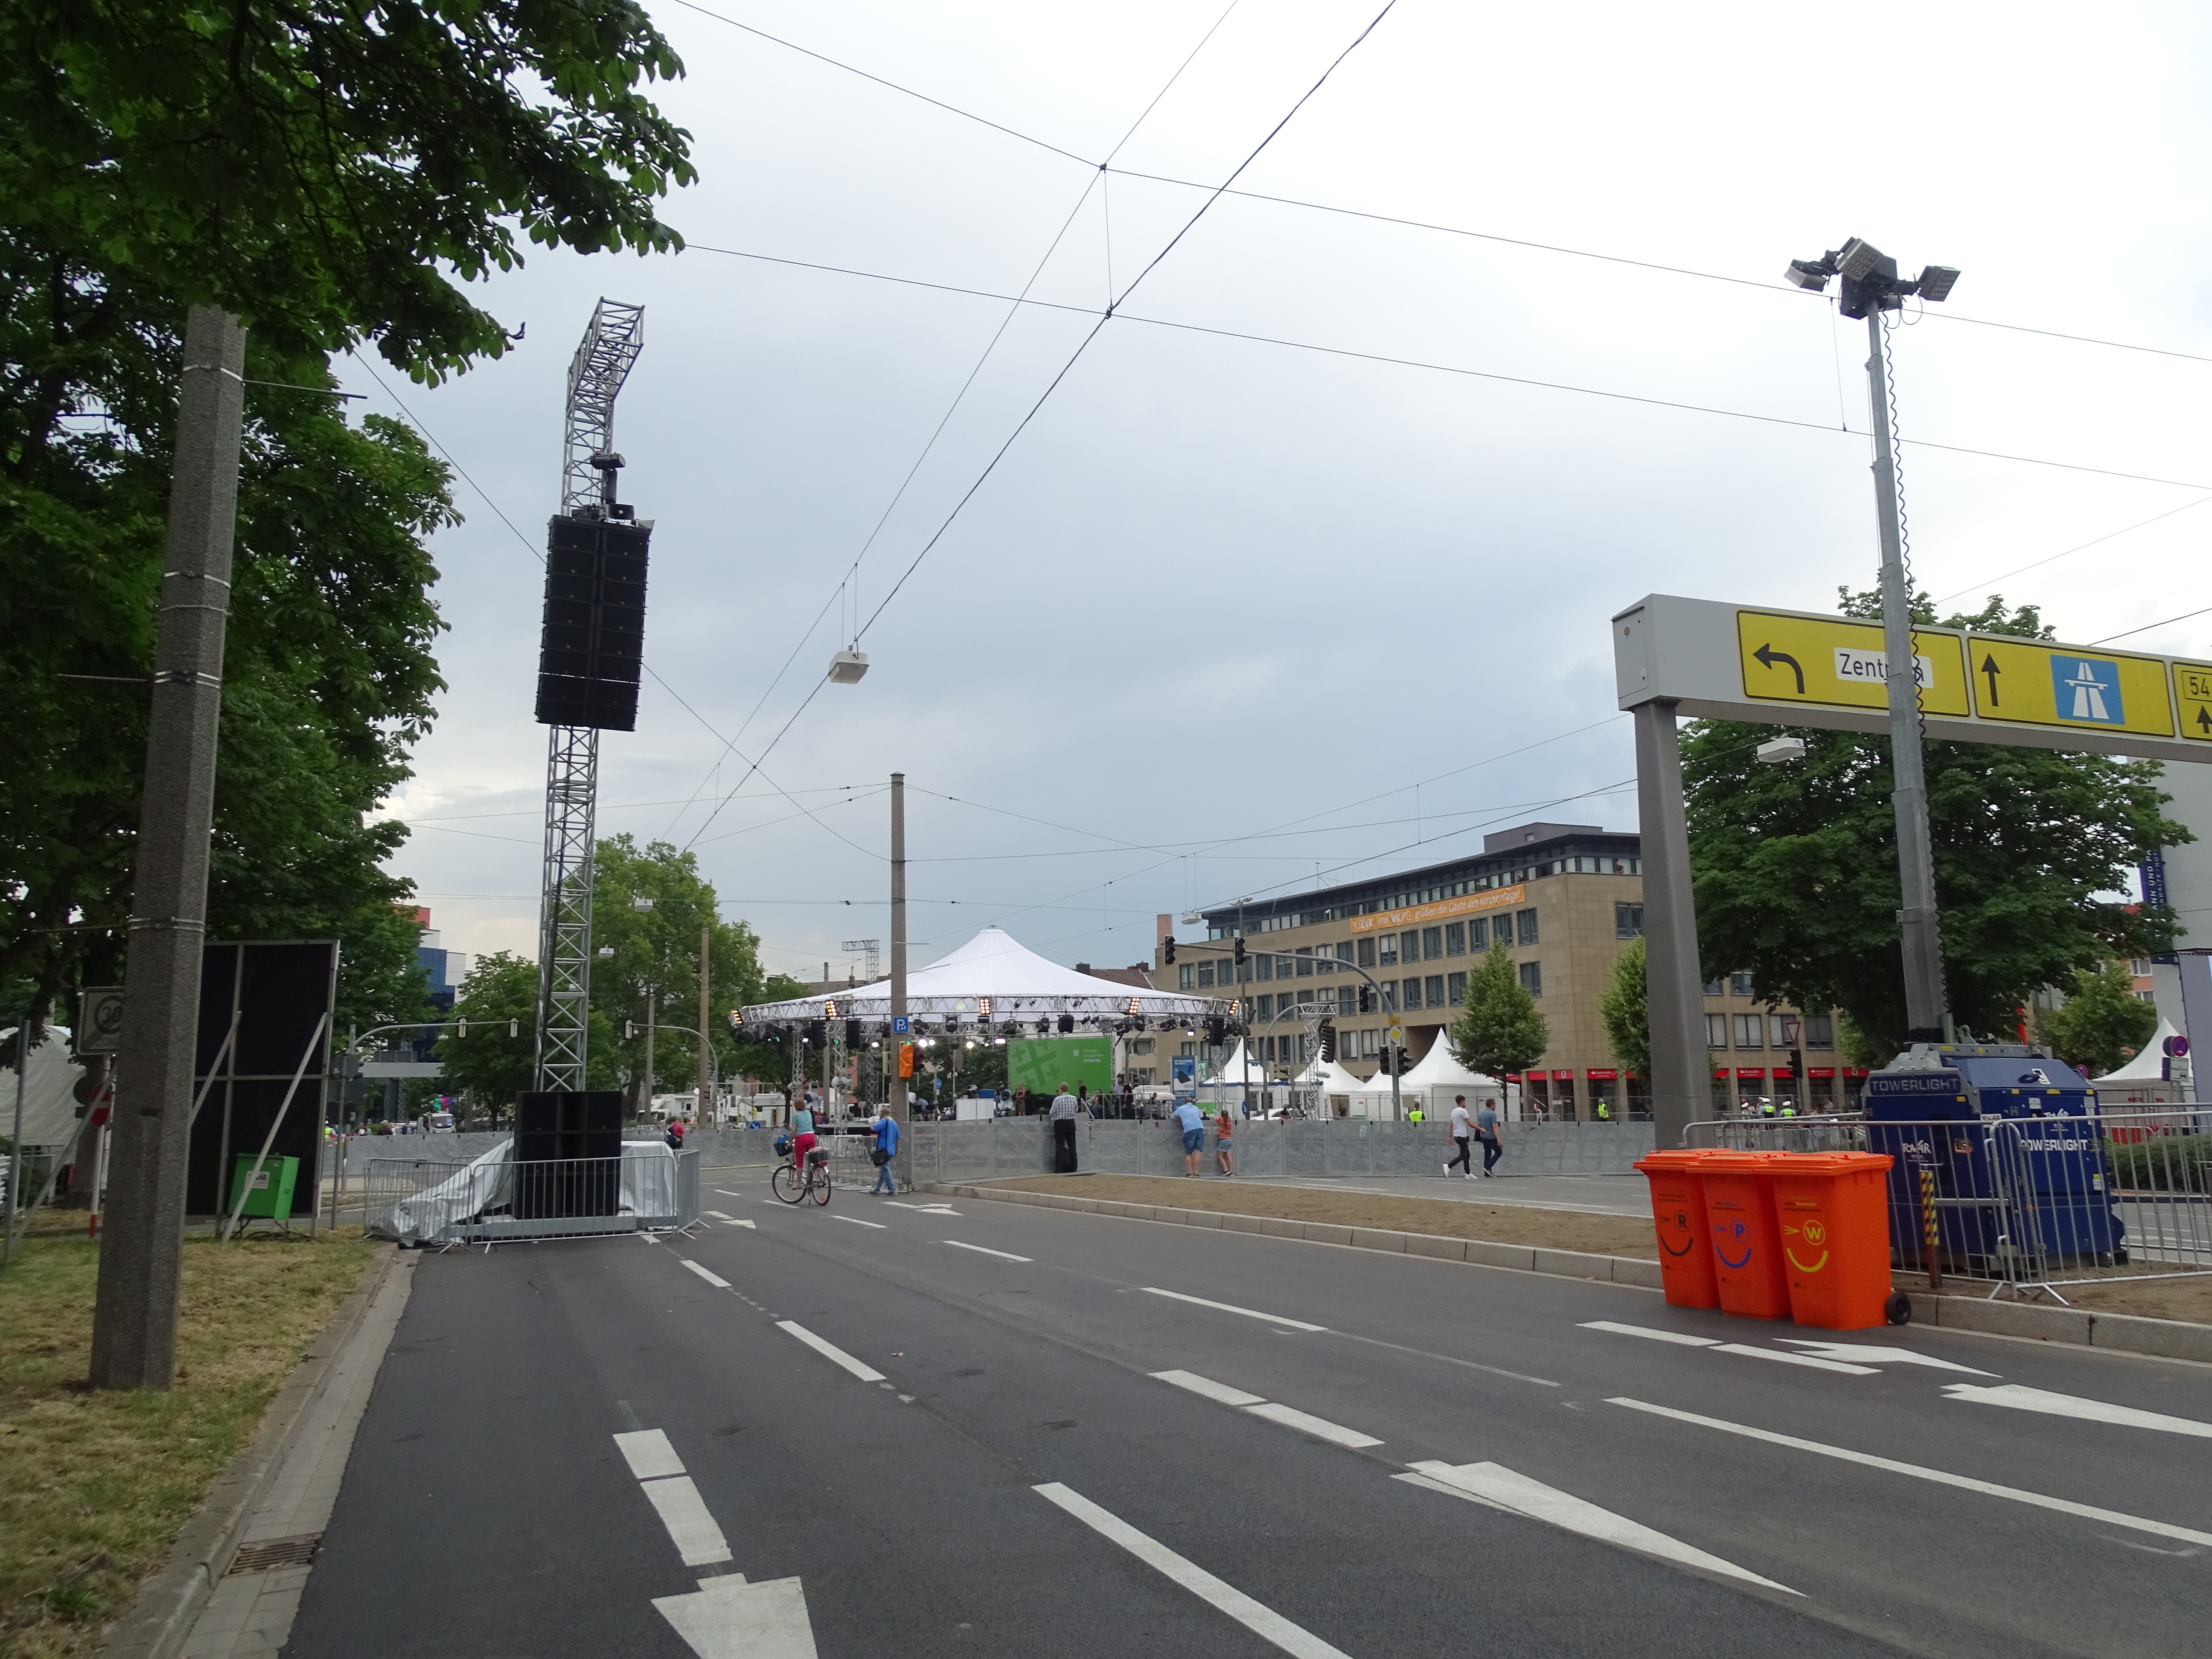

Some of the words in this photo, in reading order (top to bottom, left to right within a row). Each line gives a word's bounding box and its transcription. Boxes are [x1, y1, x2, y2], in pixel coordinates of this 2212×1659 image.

[1839, 653, 1924, 682] Zentrm
[2189, 676, 2209, 697] 54
[1415, 907, 1437, 921] grüßen
[1438, 904, 1447, 914] die
[1449, 901, 1466, 912] Gäste
[1467, 899, 1479, 908] des
[1480, 889, 1520, 906] Kirchentags!
[101, 1005, 122, 1024] 30
[896, 1019, 905, 1031] P
[1871, 1078, 1958, 1091] TOWERLIGHT
[1677, 1214, 1687, 1228] R
[1734, 1223, 1745, 1237] P
[1805, 1227, 1822, 1240] W
